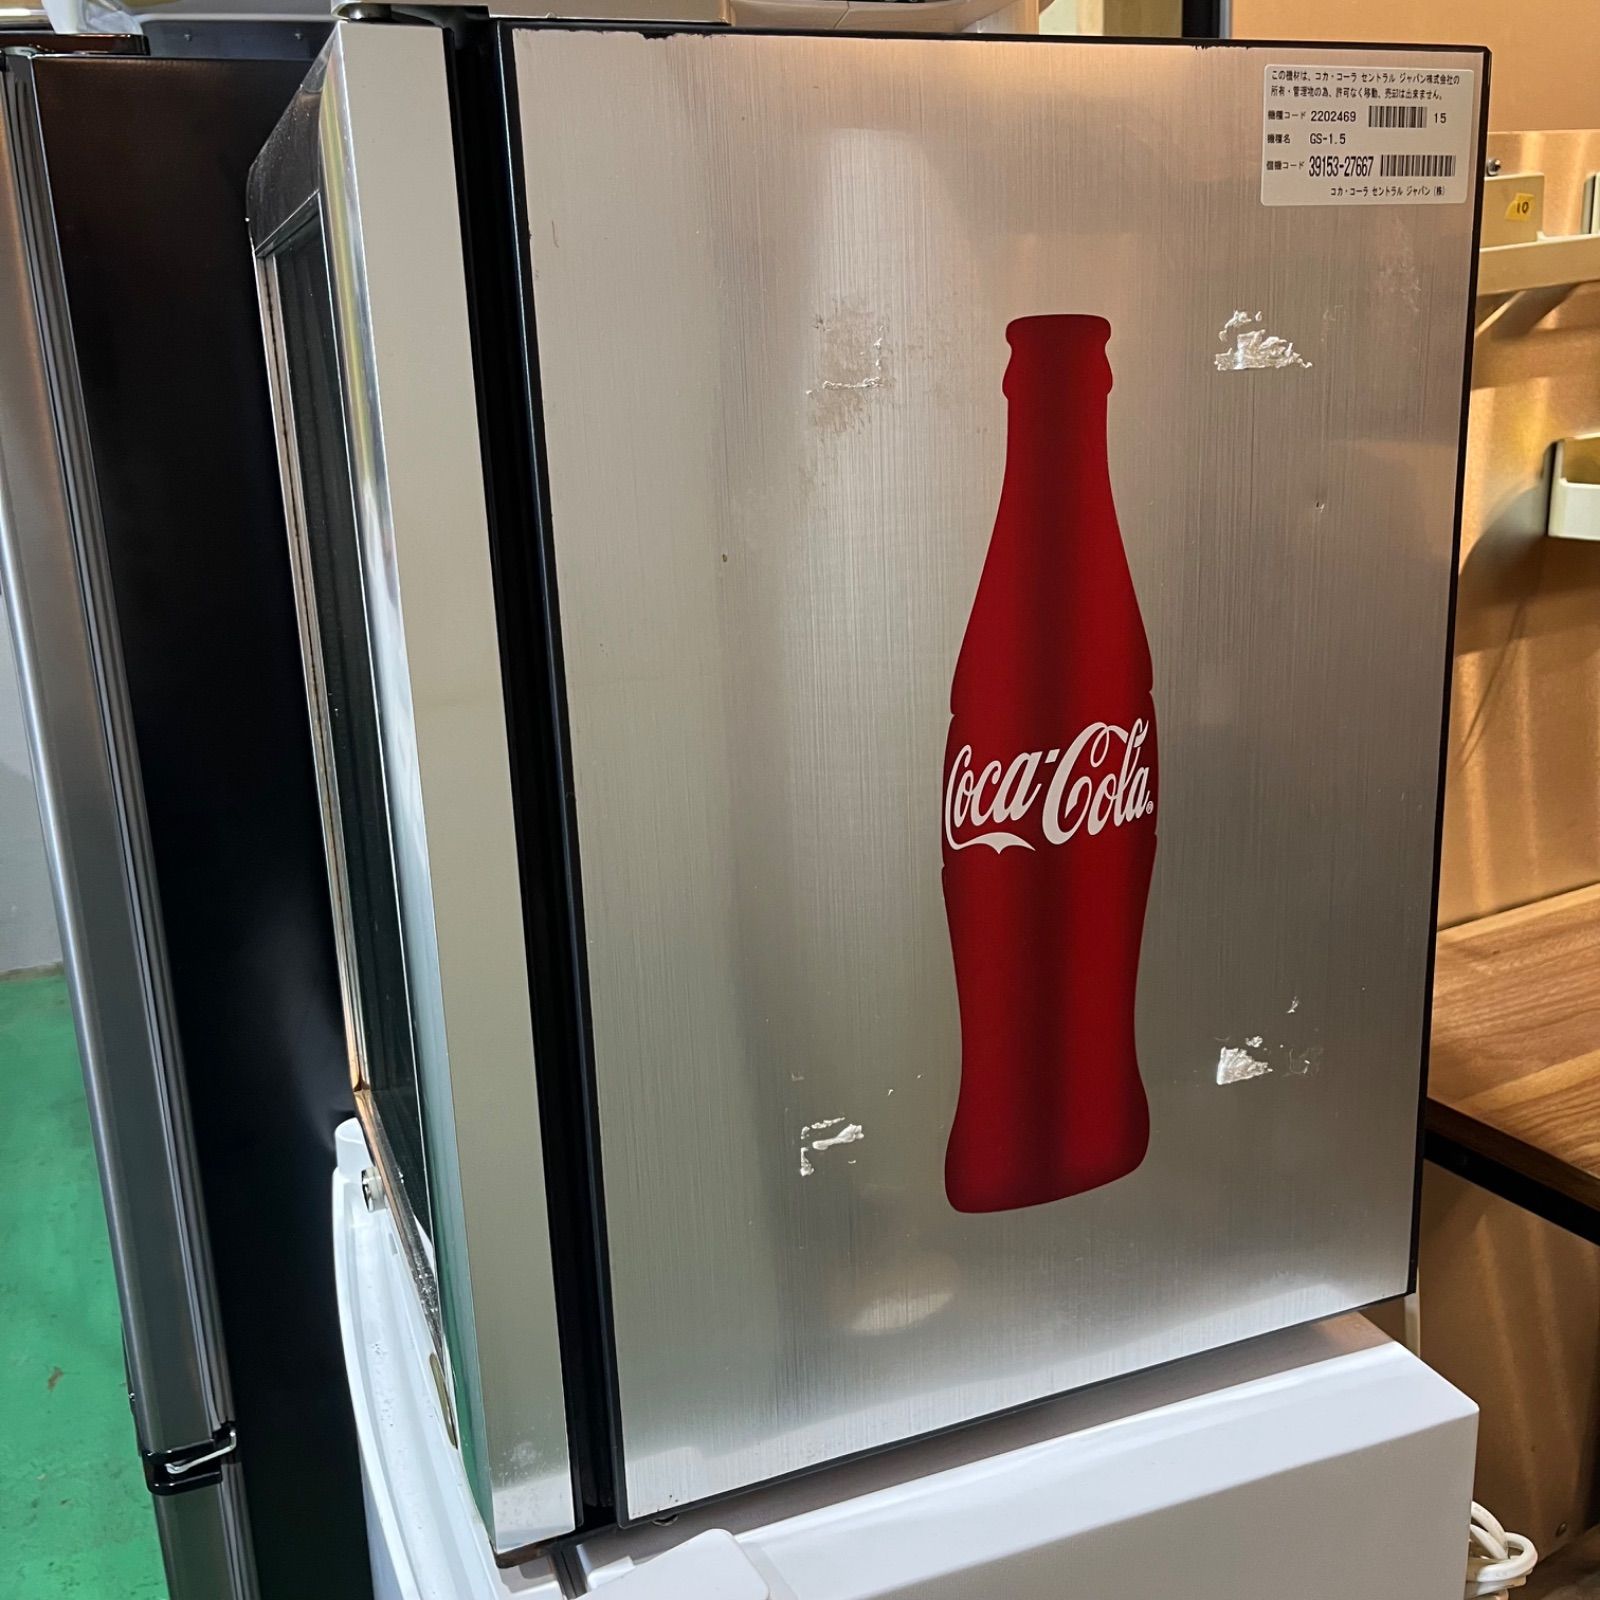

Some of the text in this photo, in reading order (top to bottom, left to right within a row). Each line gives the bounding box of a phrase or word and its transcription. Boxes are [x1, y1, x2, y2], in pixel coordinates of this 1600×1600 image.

[1361, 71, 1396, 83] セントラル
[1310, 110, 1357, 123] 2202469
[1433, 112, 1447, 124] 15
[1267, 133, 1346, 145] 機種名 GS-1.5
[1308, 155, 1374, 177] 39153-27667
[1330, 186, 1369, 197] コカ・コーラ
[1372, 186, 1404, 197] セントラル
[1406, 185, 1431, 197] ジャパン
[1516, 201, 1530, 215] 10
